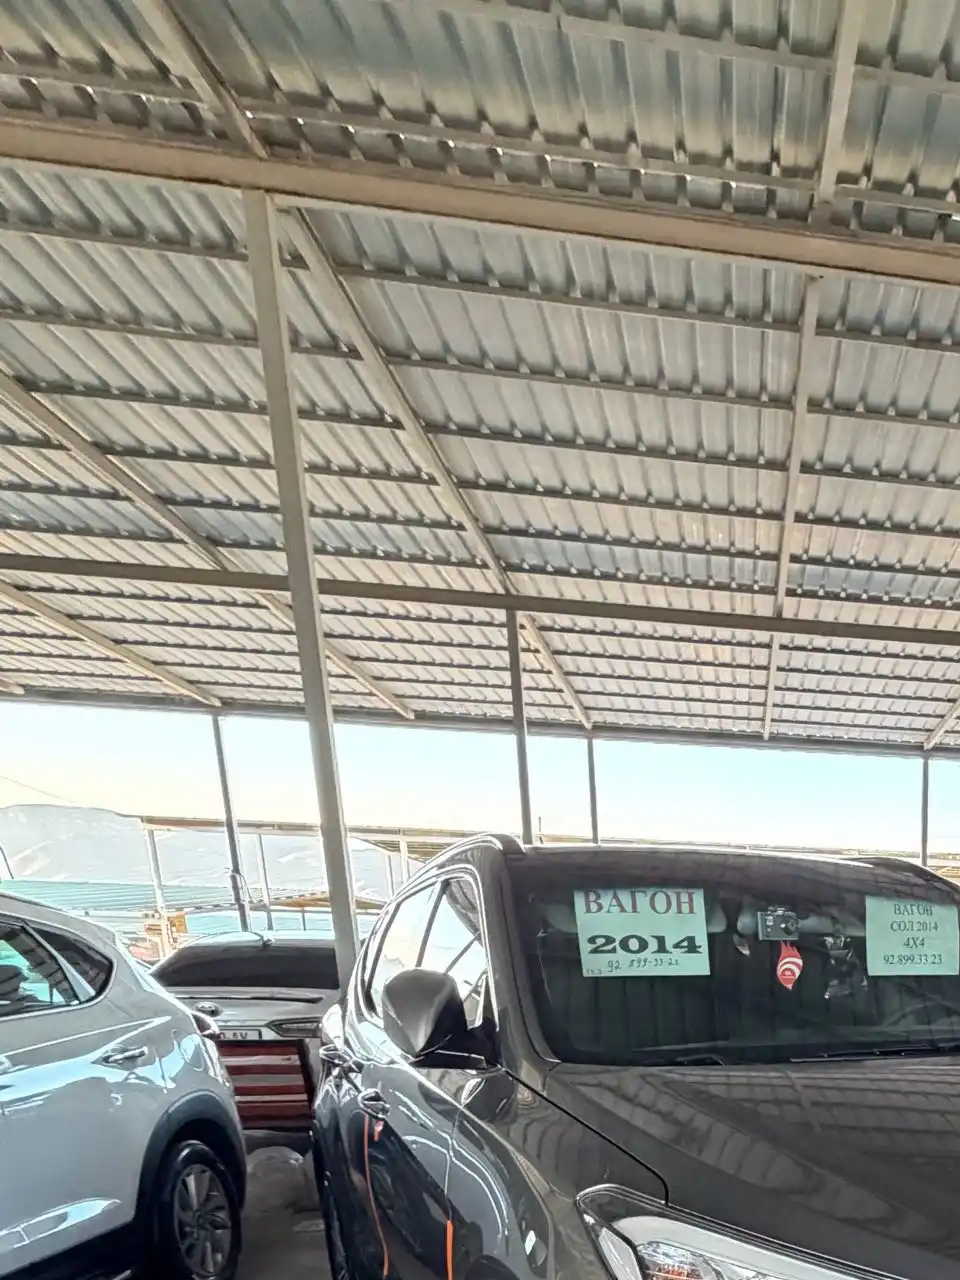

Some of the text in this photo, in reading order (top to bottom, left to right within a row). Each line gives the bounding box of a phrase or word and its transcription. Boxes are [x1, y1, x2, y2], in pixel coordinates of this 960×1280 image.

[584, 889, 697, 915] ВАГОН
[894, 903, 934, 917] ВАГОН
[890, 920, 939, 932] СОЛ 2014
[587, 934, 703, 955] 2014
